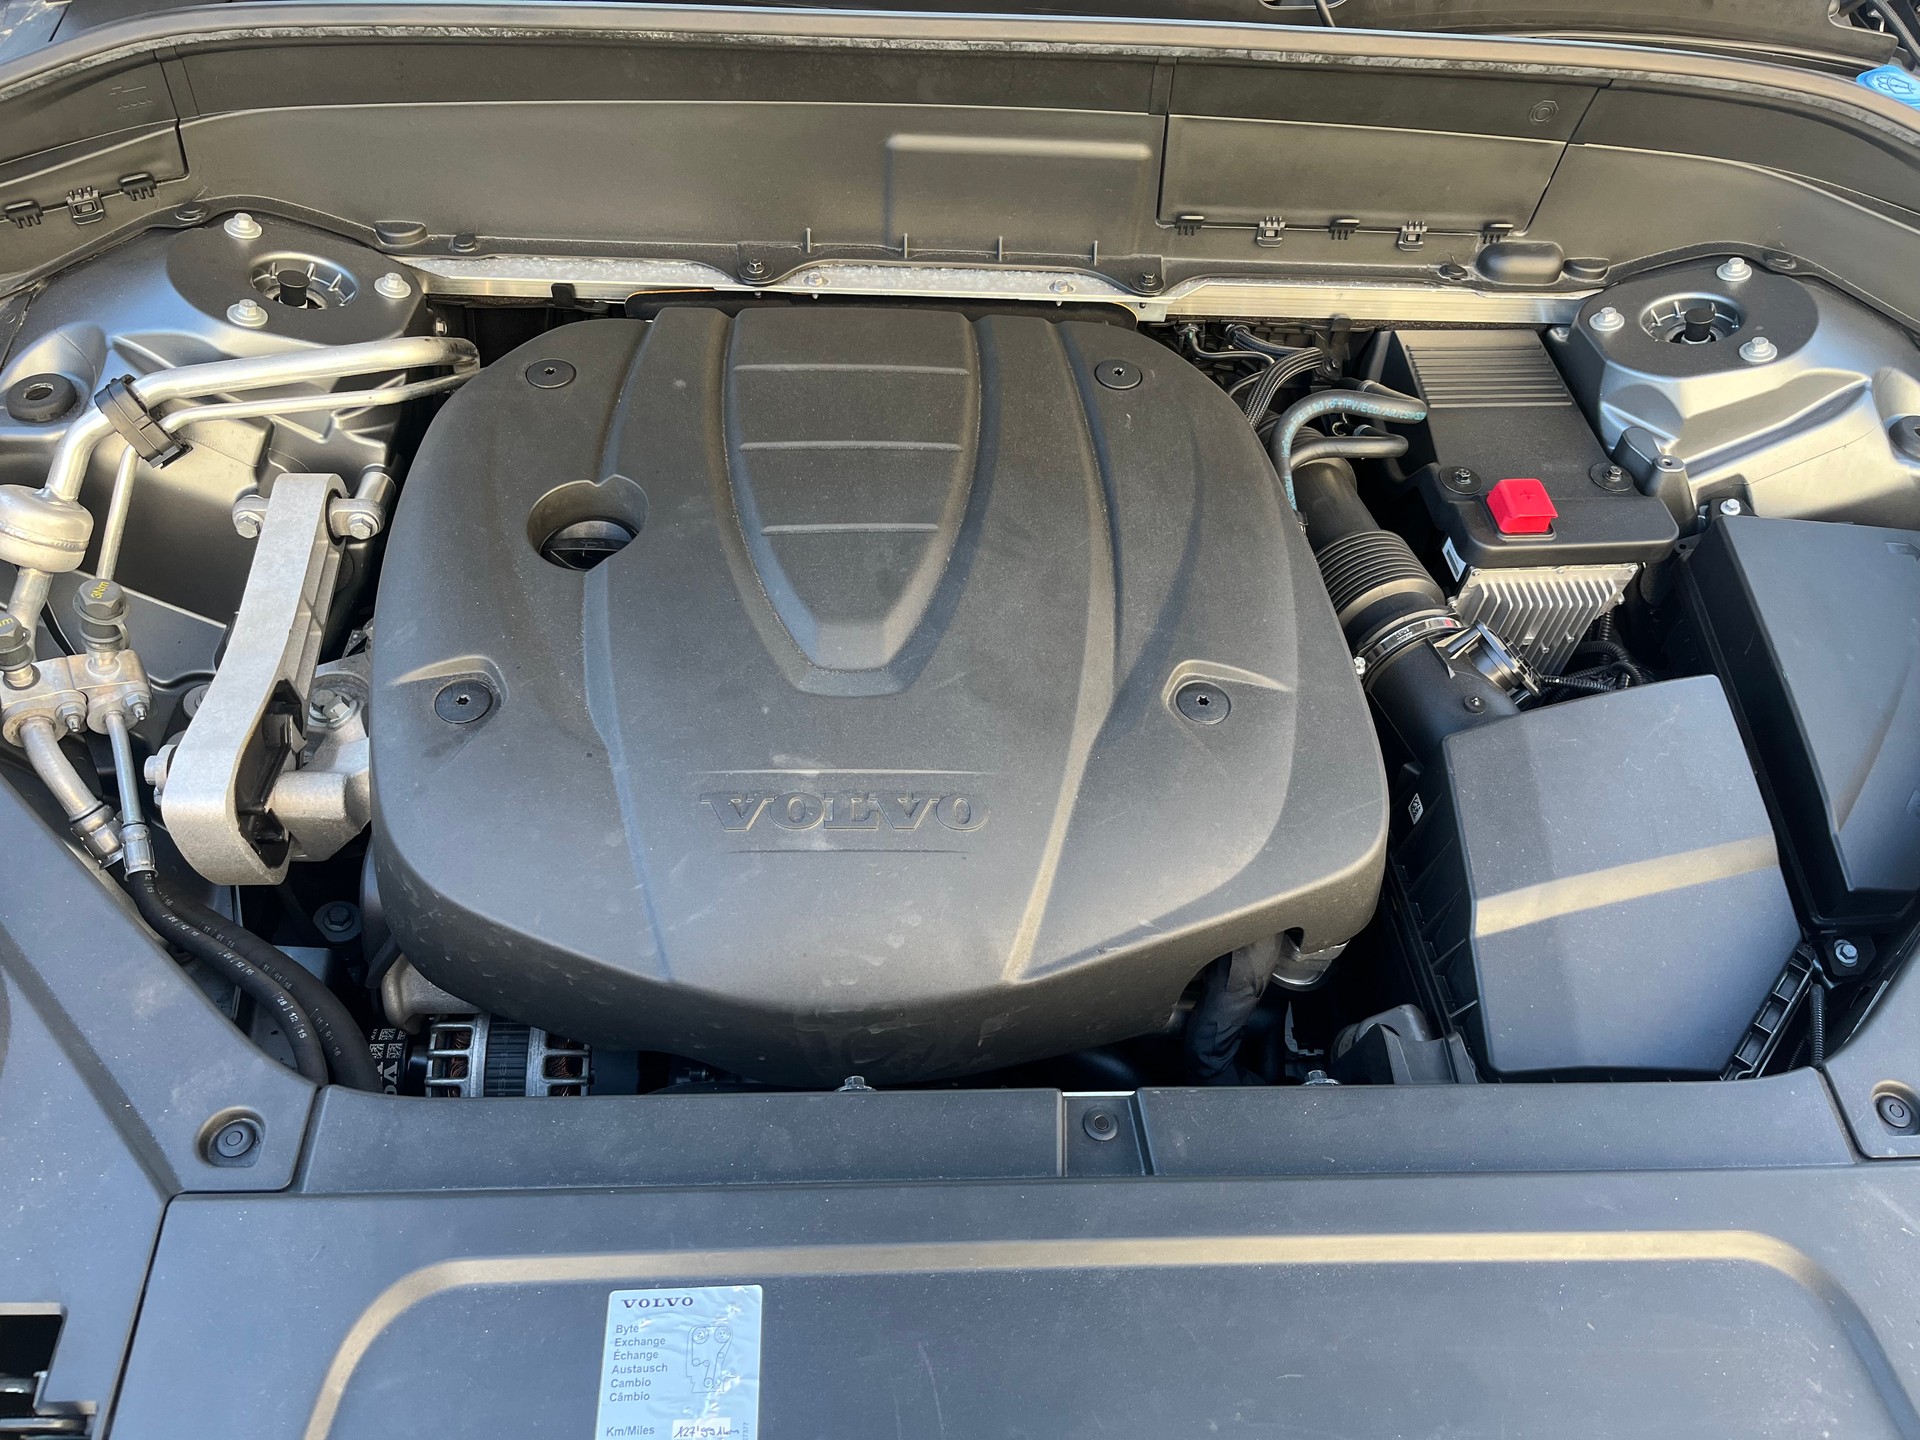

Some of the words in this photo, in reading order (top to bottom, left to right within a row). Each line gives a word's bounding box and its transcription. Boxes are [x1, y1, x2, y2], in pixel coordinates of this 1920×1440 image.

[91, 581, 110, 599] 3Nm
[701, 791, 990, 831] VOLVO
[621, 1297, 694, 1308] VOLVO
[616, 1325, 639, 1335] Byte
[615, 1338, 666, 1347] Exchange
[614, 1349, 659, 1361] Échange
[611, 1363, 668, 1374] Austausch
[611, 1378, 651, 1388] Cambio
[606, 1426, 655, 1436] Km/Miles
